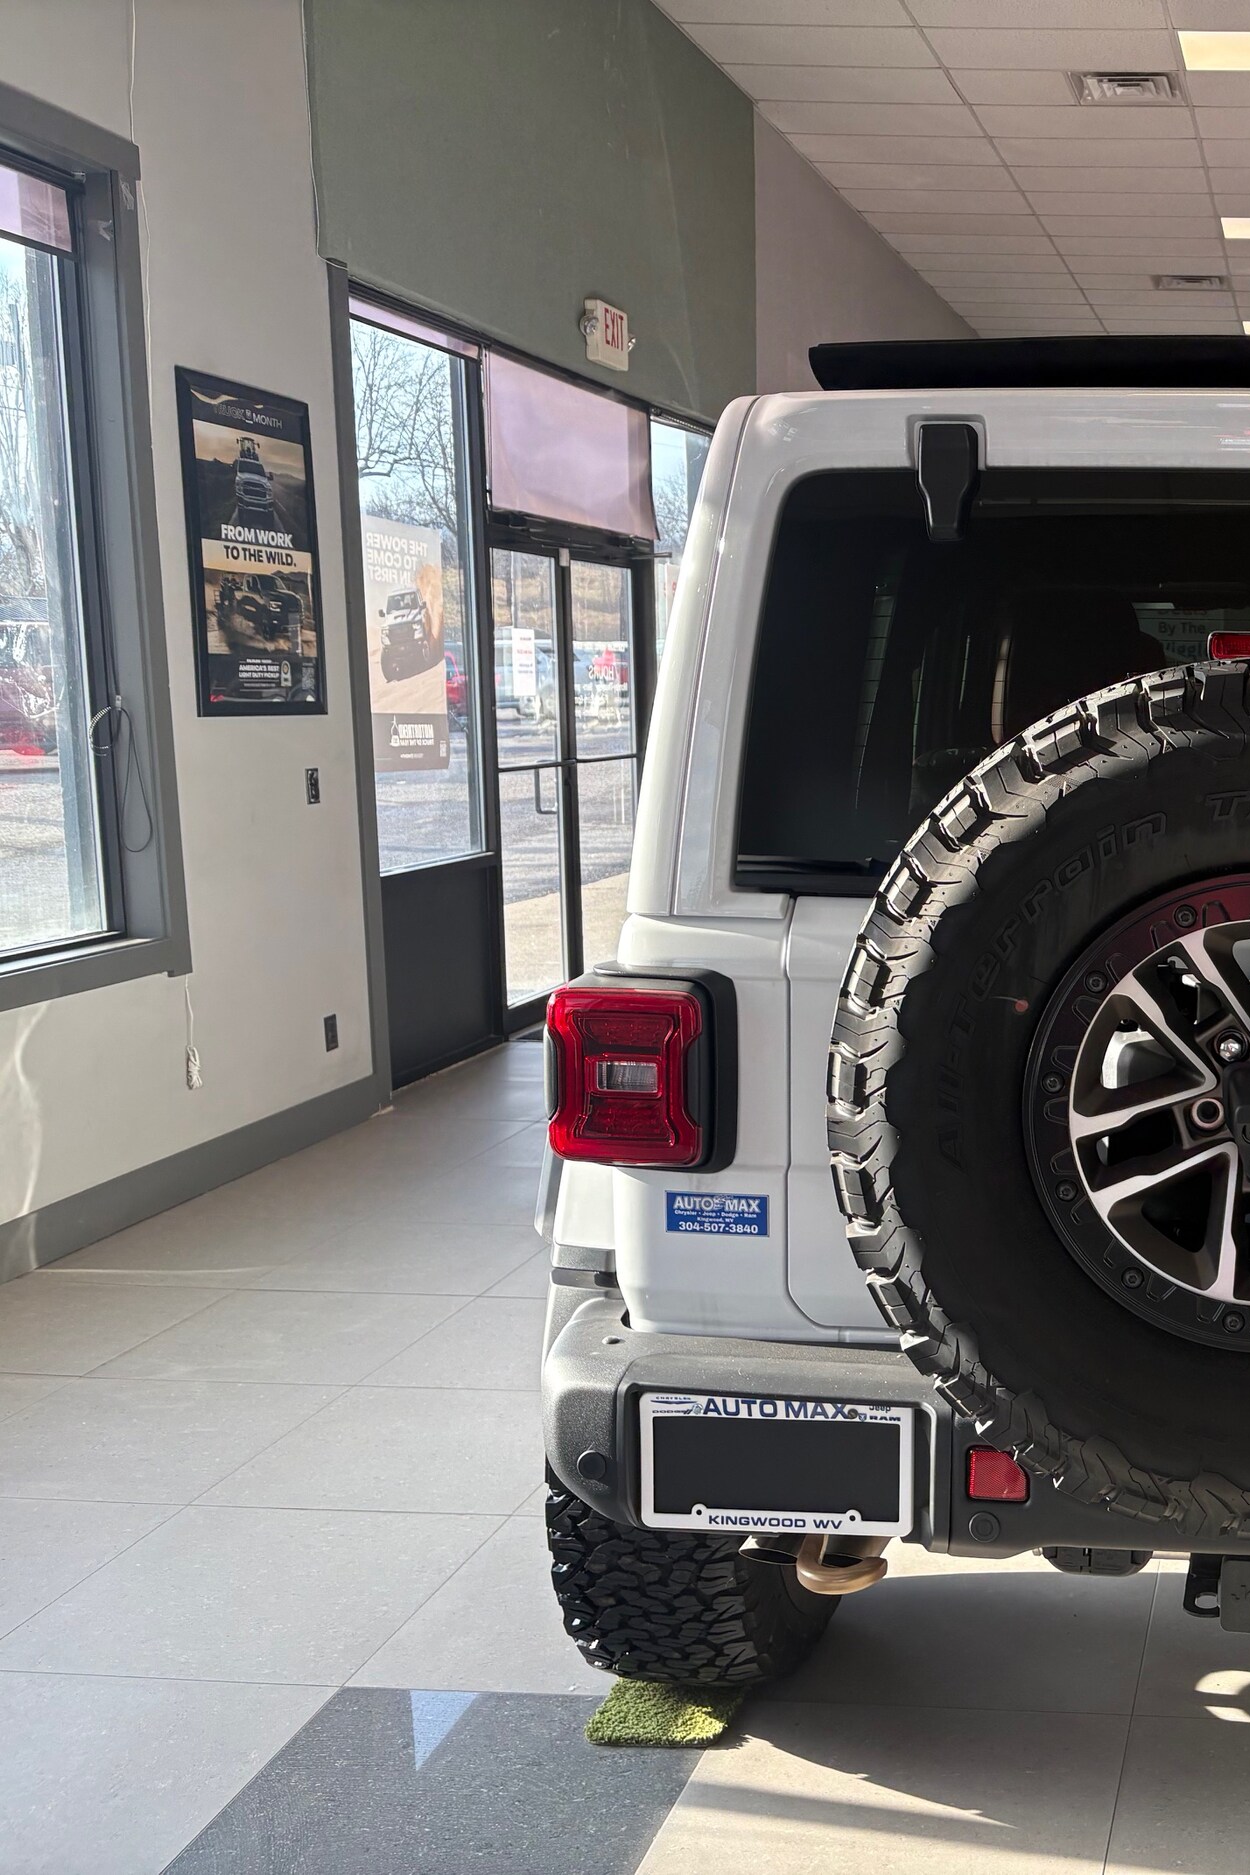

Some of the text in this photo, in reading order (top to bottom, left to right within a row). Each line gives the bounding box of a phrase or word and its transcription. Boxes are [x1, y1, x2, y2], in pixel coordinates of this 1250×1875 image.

[604, 307, 624, 351] EXIT
[252, 411, 283, 430] MONTH
[221, 524, 294, 548] FROM WORK
[223, 544, 297, 568] TO THE WILD.
[1158, 621, 1206, 637] By The
[673, 1196, 714, 1211] AUTO
[725, 1199, 761, 1213] MAX
[679, 1222, 759, 1234] 304-507-3840
[702, 1398, 854, 1420] AUTO MAX
[708, 1514, 842, 1529] KINGWOOD WV
